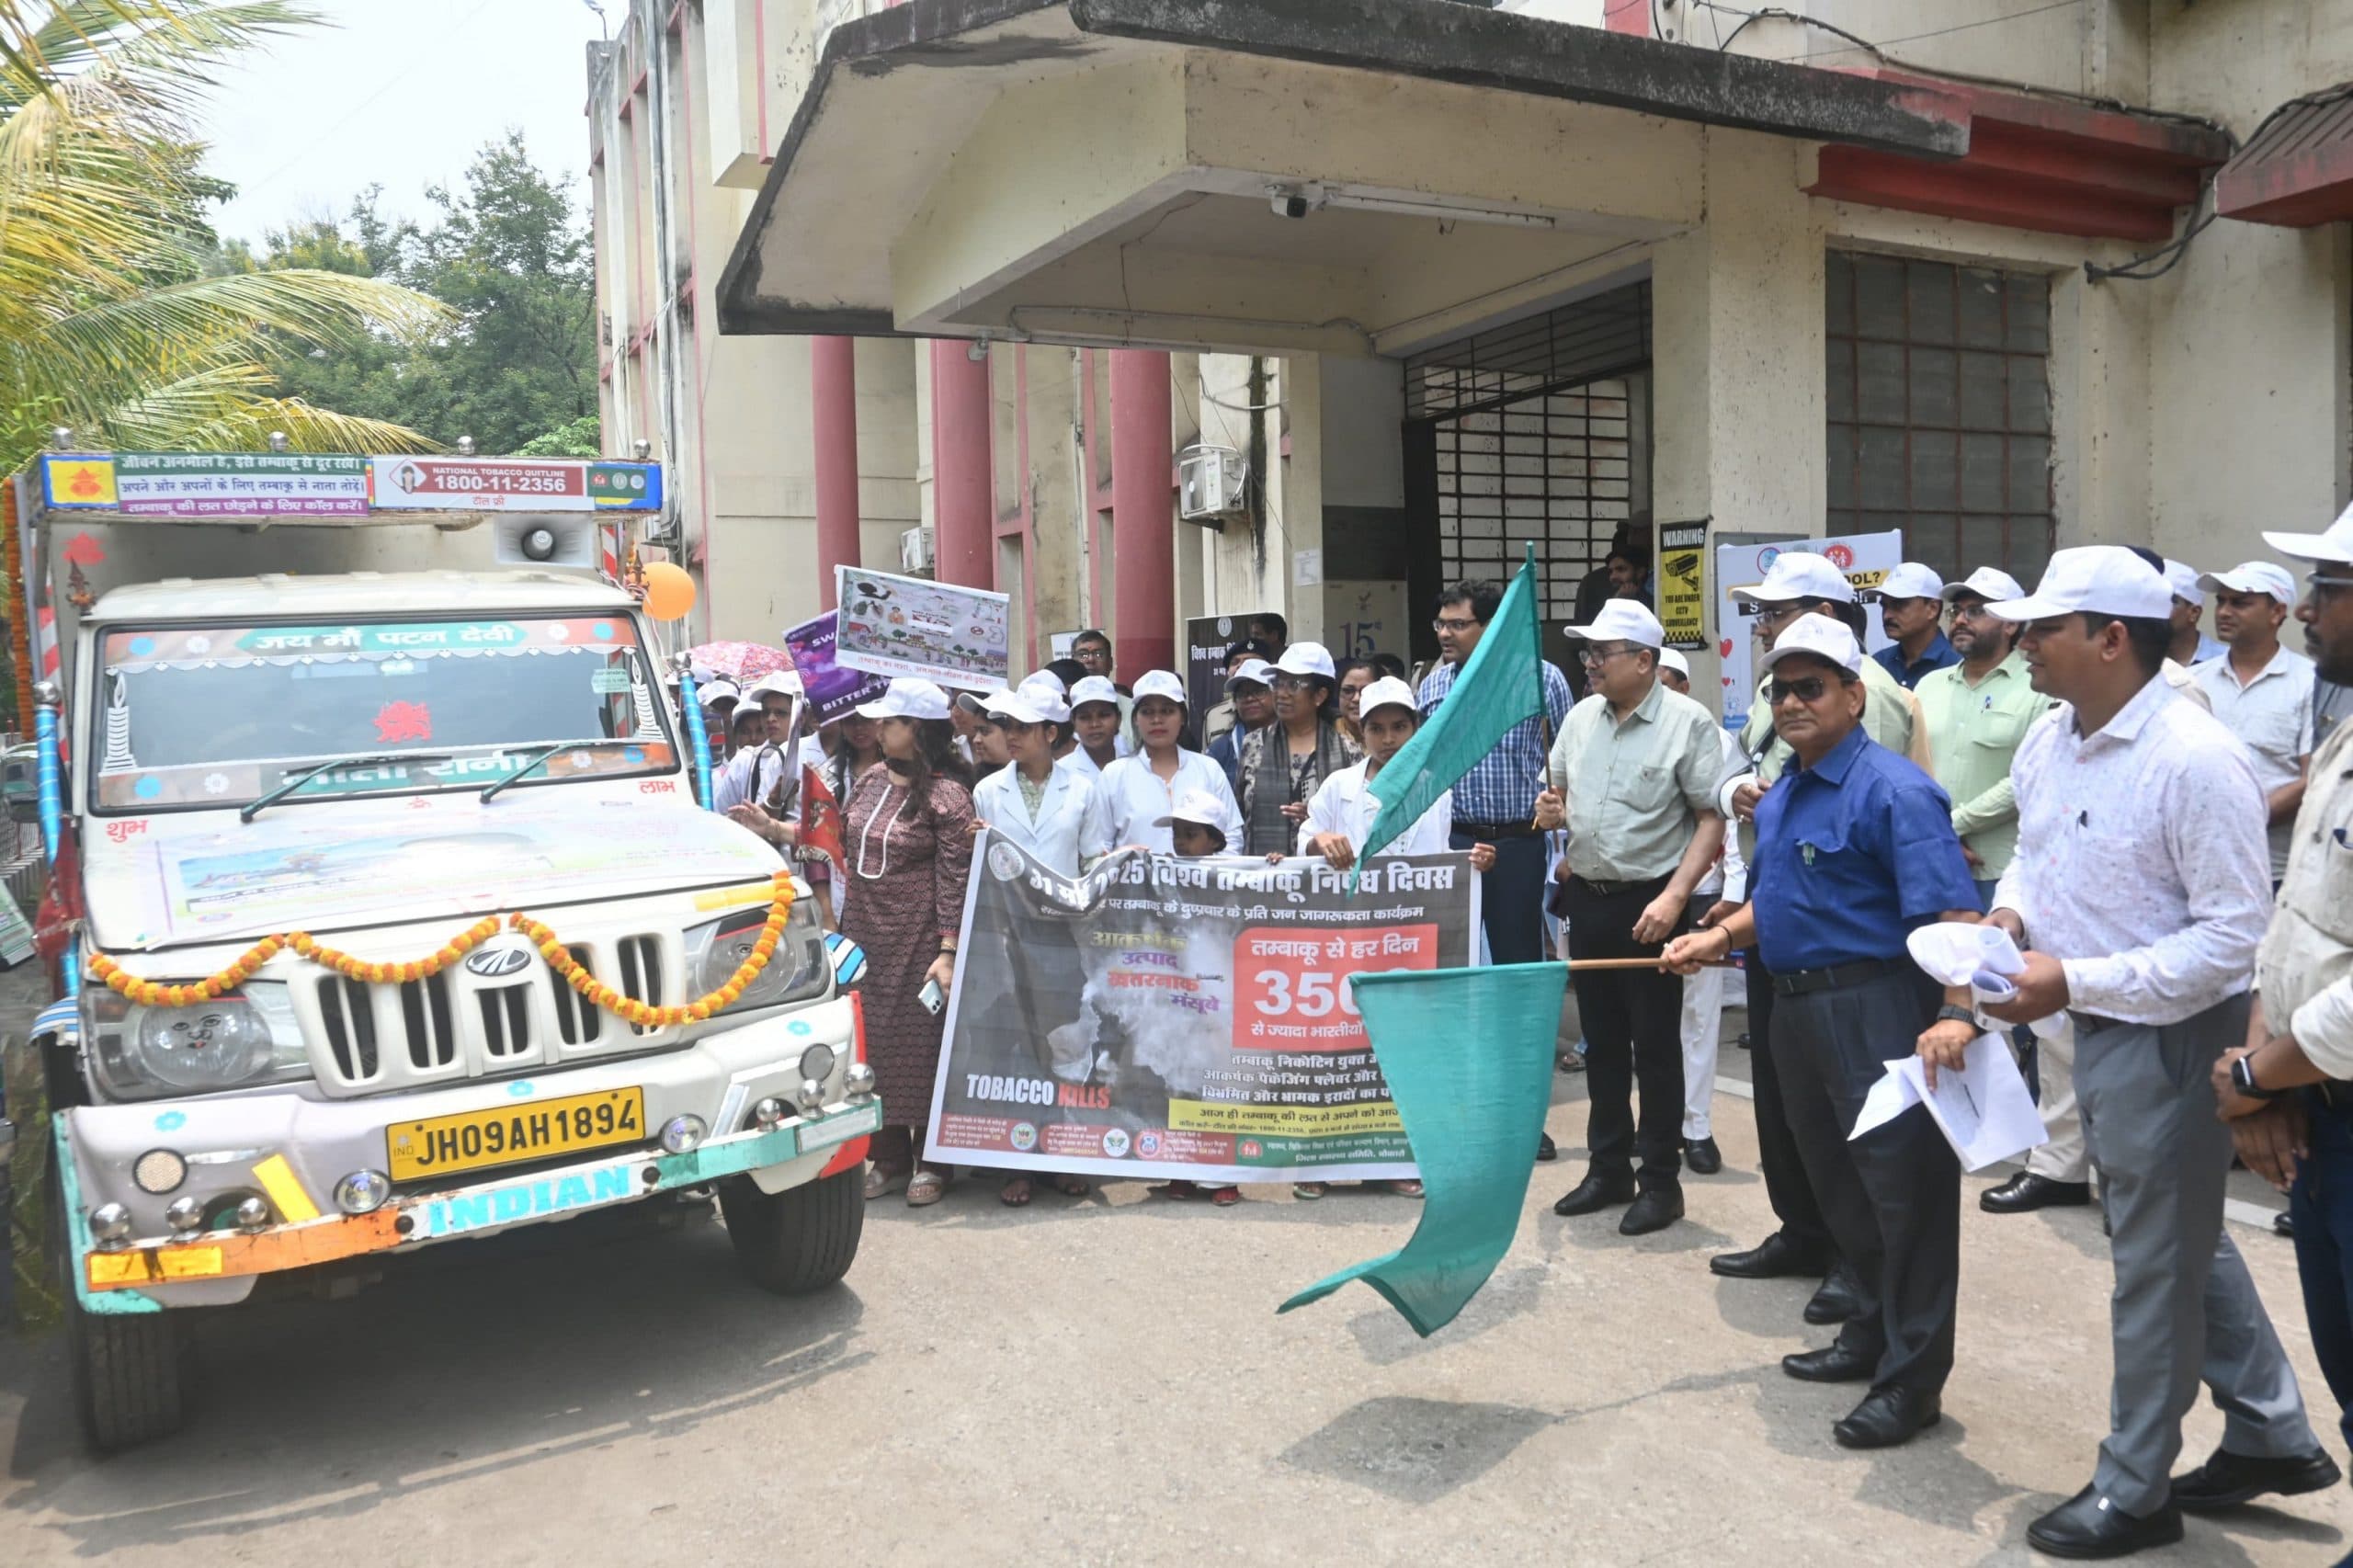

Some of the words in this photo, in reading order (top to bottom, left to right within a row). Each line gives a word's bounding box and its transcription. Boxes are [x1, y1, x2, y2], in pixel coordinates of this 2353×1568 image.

[432, 466, 478, 475] NATIONAL
[480, 468, 523, 477] TOBACCO
[524, 470, 566, 478] QUITLINE
[121, 478, 149, 493] अपने
[154, 478, 176, 492] और
[180, 478, 212, 492] अपनों
[216, 477, 228, 490] के
[232, 477, 255, 492] लिए
[298, 477, 308, 491] से
[312, 481, 336, 491] नाता
[434, 475, 567, 493] 1800-11-2356
[176, 499, 196, 511] की
[260, 499, 274, 511] के
[276, 498, 302, 511] लिए
[1663, 527, 1704, 548] WARNING
[1676, 606, 1688, 615] CCTV
[256, 633, 313, 650] जय
[374, 630, 448, 645] पटन
[458, 624, 515, 642] देवी
[822, 687, 871, 711] BITTER
[639, 780, 676, 793] लाभ
[106, 820, 149, 844] शुभ
[1151, 855, 1211, 892] विश्व
[1216, 866, 1306, 903] तम्बाकू
[1387, 861, 1456, 893] दिवस
[1108, 898, 1122, 909] पर
[1123, 899, 1164, 917] तम्बाकू
[1163, 900, 1178, 914] के
[1227, 904, 1241, 917] के
[1244, 904, 1268, 920] प्रति
[1270, 908, 1297, 920] जन
[1300, 909, 1370, 922] जागरूकता
[1374, 904, 1425, 920] कार्यक्रम
[1250, 938, 1321, 965] तम्बाकू
[1326, 937, 1347, 959] से
[1350, 939, 1380, 960] हर
[1382, 933, 1421, 955] दिन
[1121, 951, 1178, 970] उत्पाद
[1108, 971, 1200, 993] खतरनाक
[1169, 992, 1221, 1016] मंसूबे
[1250, 1019, 1265, 1036] से
[1267, 1023, 1307, 1038] ज्यादा
[1231, 1054, 1275, 1071] तम्बाकू
[1277, 1054, 1335, 1068] निकोटिन
[1337, 1054, 1366, 1071] युक्त
[1354, 1068, 1378, 1083] और
[965, 1073, 1055, 1107] TOBACCO
[1057, 1083, 1112, 1110] KILLS
[1253, 1089, 1279, 1102] और
[1324, 1086, 1358, 1105] इरादों
[1359, 1088, 1377, 1099] का
[1199, 1108, 1224, 1118] आज
[1227, 1108, 1239, 1119] ही
[1281, 1110, 1295, 1121] की
[1321, 1111, 1330, 1121] से
[416, 1098, 636, 1165] JH09AH1894
[392, 1145, 414, 1157] IND
[427, 1165, 631, 1235] INDIAN
